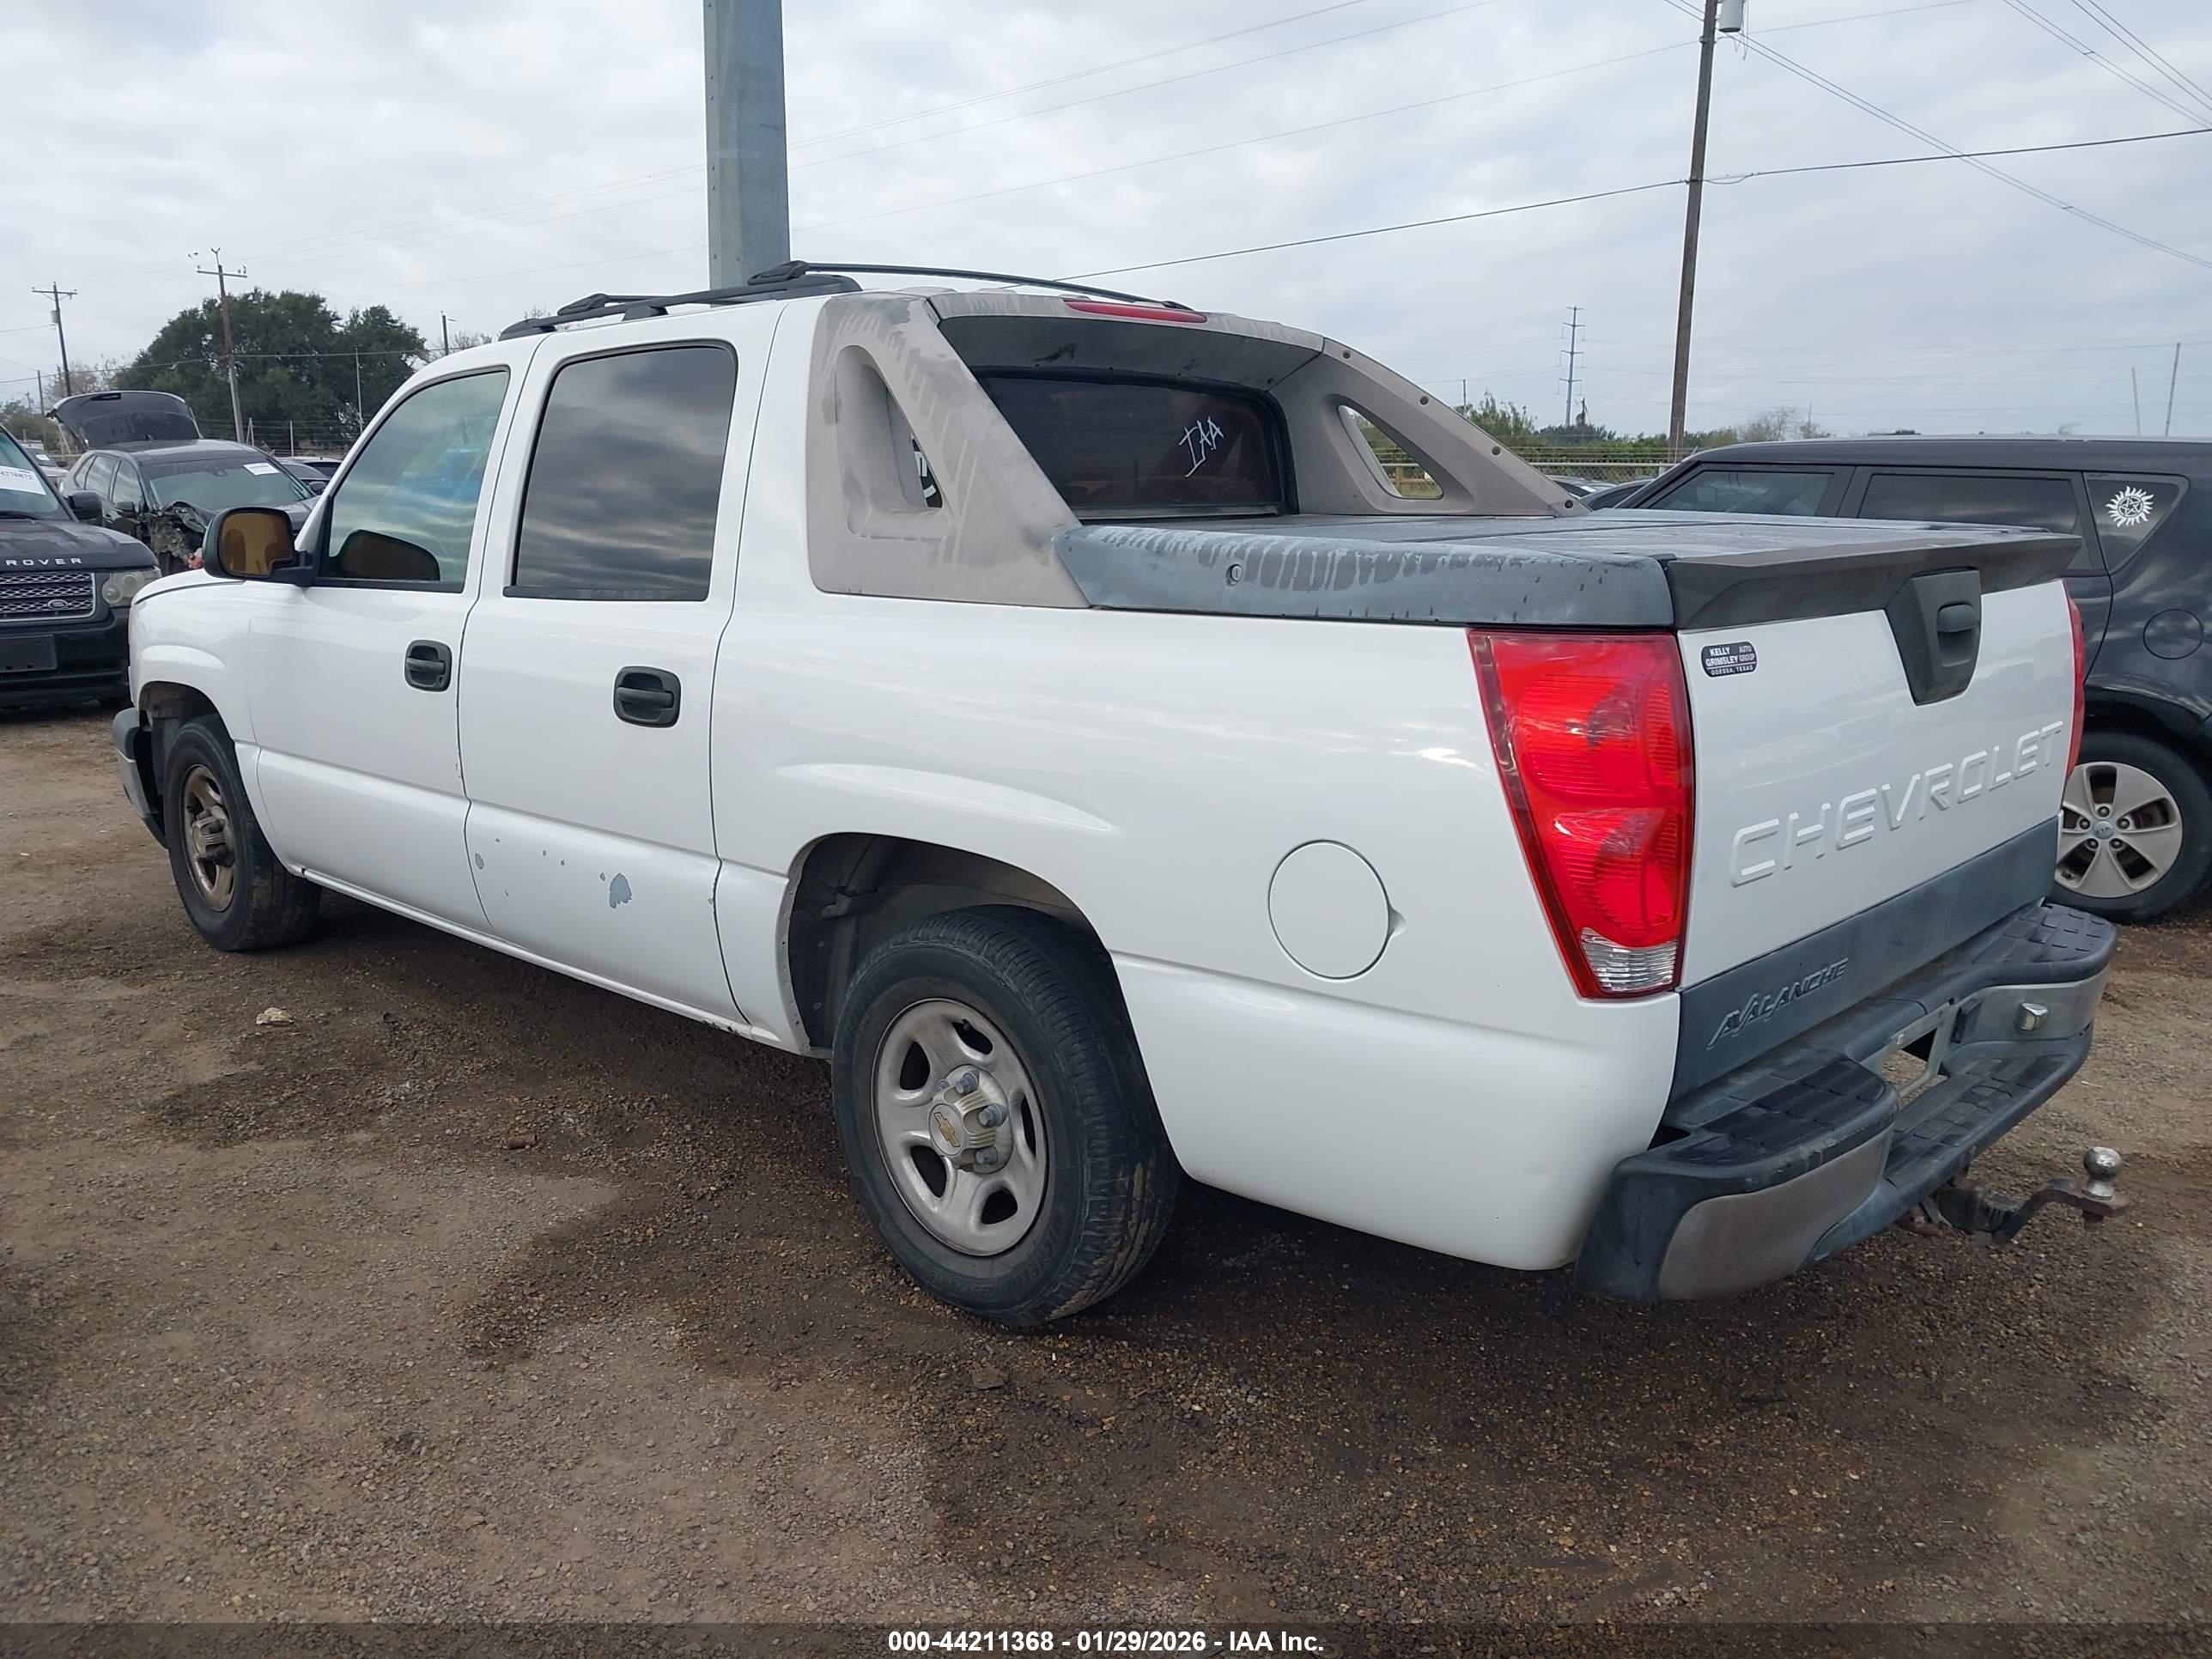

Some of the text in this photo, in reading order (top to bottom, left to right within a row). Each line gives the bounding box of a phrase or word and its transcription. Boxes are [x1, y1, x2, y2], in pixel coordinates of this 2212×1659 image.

[1178, 416, 1224, 477] IAA
[5, 557, 82, 566] ROVER
[1705, 656, 1738, 666] GRIMSLEY
[1710, 647, 1730, 657] KELLY
[1730, 720, 2063, 888] CHEVROLET
[1706, 957, 1849, 1050] AVALANCHE
